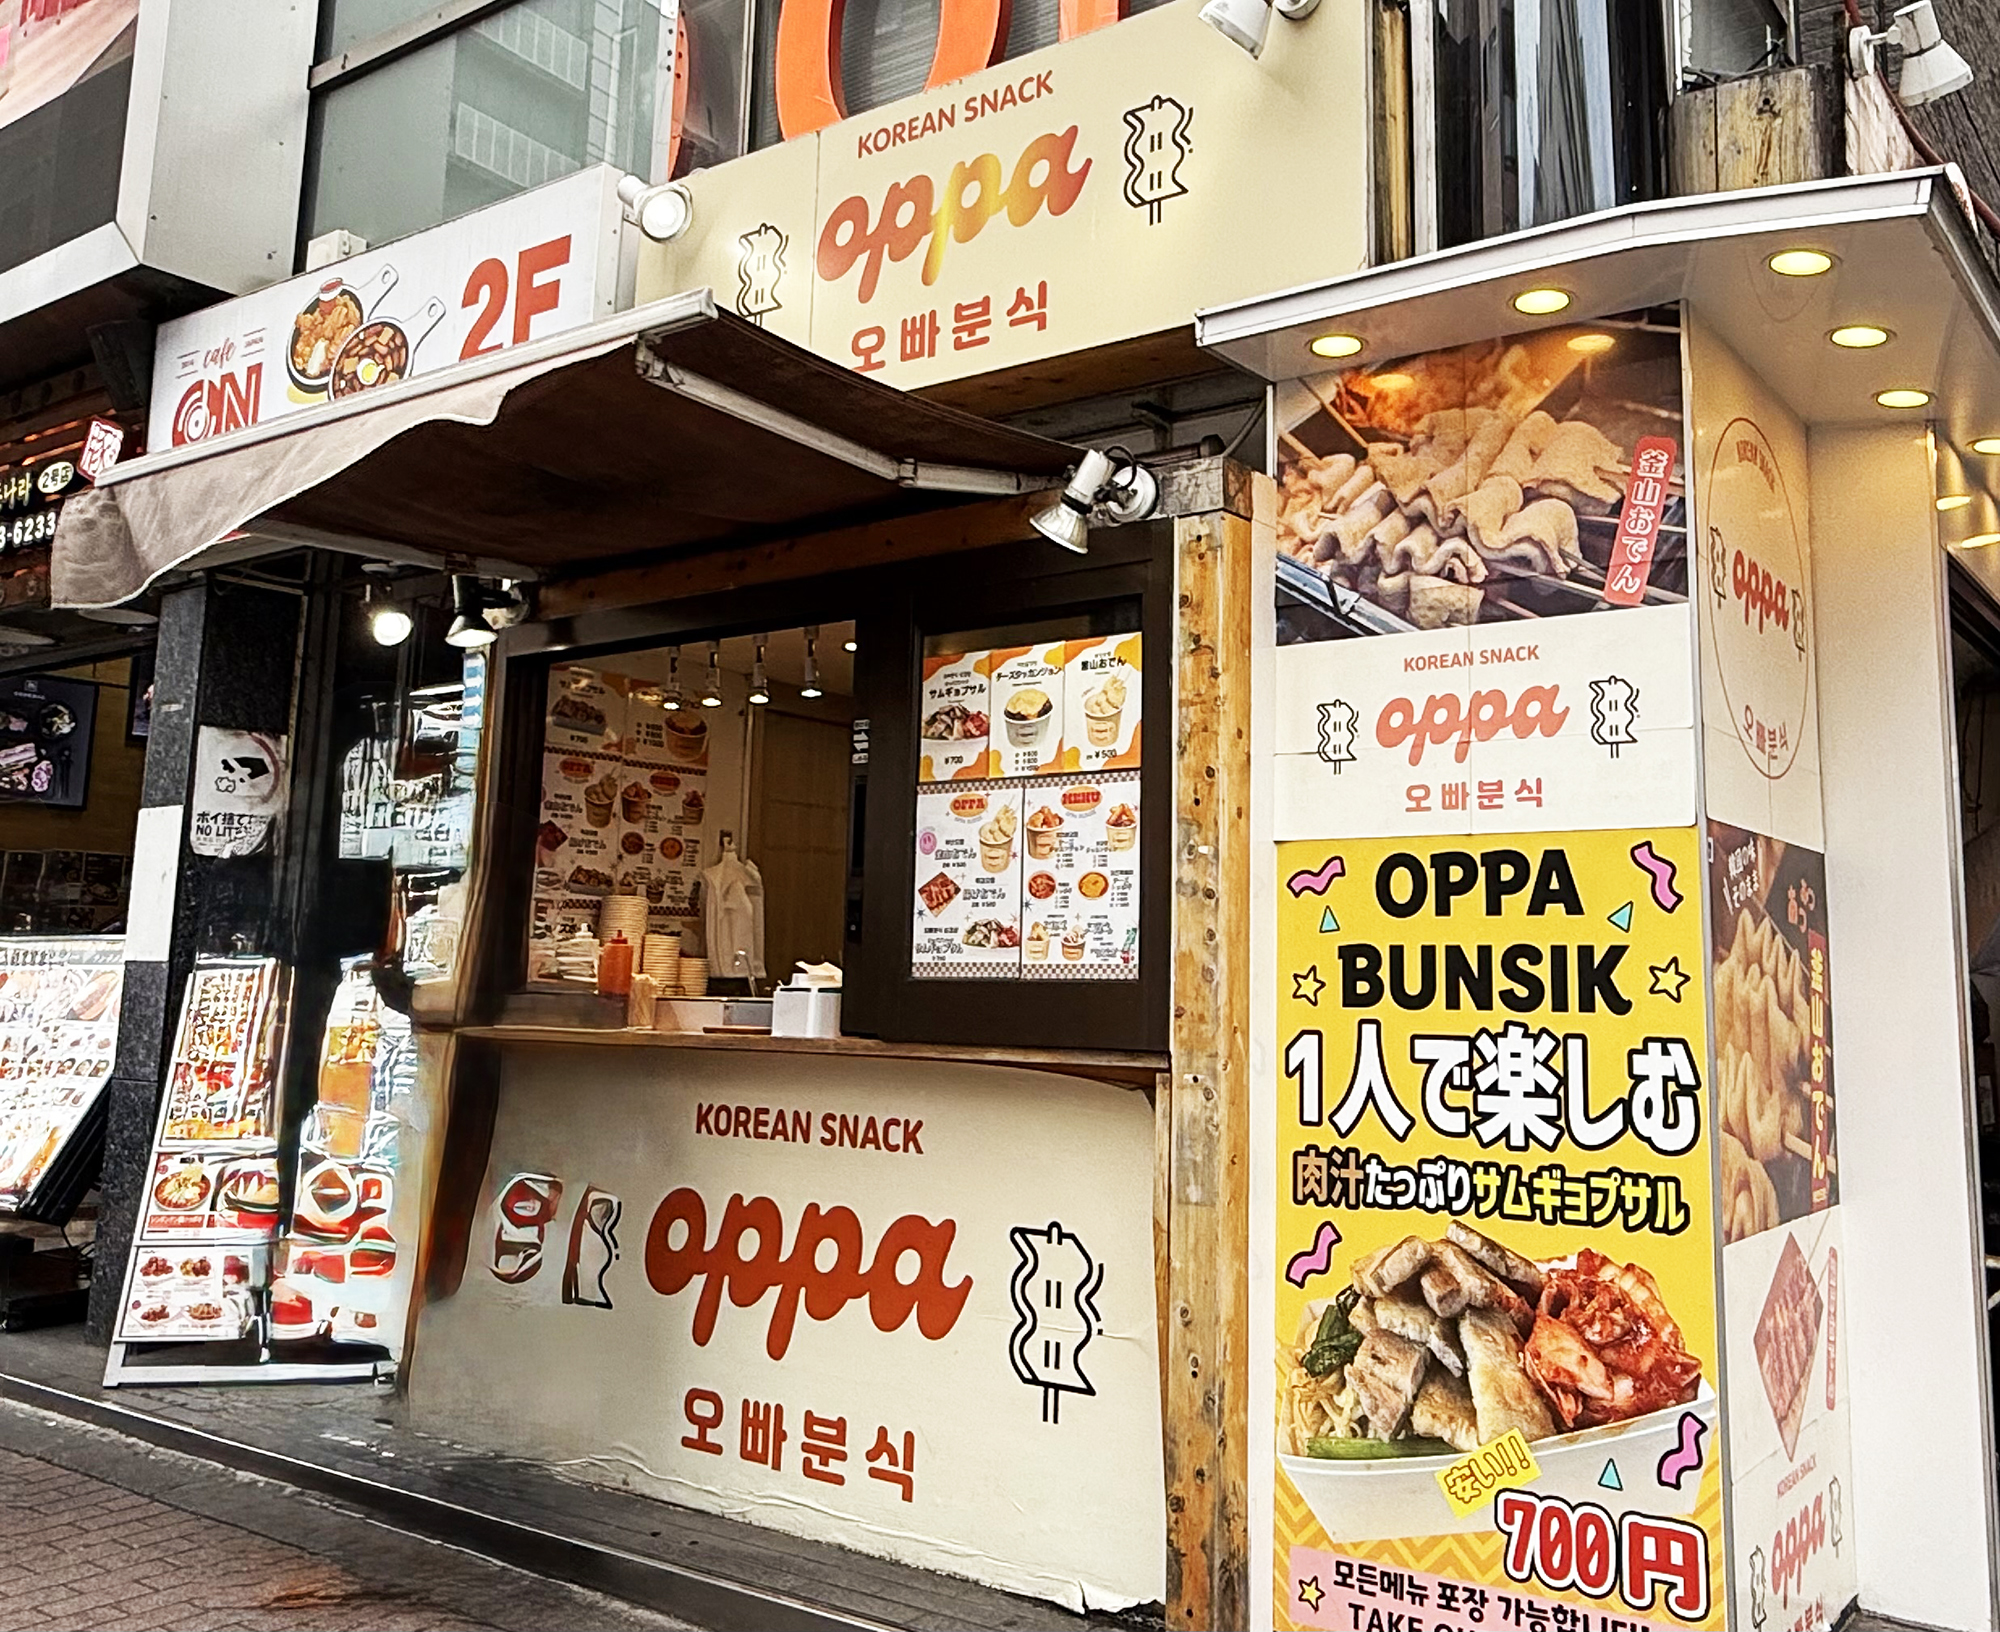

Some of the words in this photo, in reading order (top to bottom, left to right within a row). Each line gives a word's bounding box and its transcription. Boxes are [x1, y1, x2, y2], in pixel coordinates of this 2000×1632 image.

[857, 104, 957, 160] KOREAN
[963, 69, 1055, 125] SNACK
[816, 125, 1092, 304] oppa
[461, 233, 572, 361] 2F
[851, 280, 1049, 373] 오빠분식
[1609, 446, 1670, 595] 釜山おでん
[1732, 549, 1790, 635] oppa
[1403, 650, 1475, 673] KOREAN
[1480, 644, 1540, 665] SNACK
[1375, 683, 1571, 768] oppa
[1404, 777, 1544, 814] 오빠분식
[1374, 849, 1585, 919] OPPA
[1338, 943, 1633, 1016] BUNSIK
[695, 1102, 812, 1145] KOREAN
[820, 1111, 924, 1155] SNACK
[1286, 1019, 1701, 1157] 1人で楽しむ
[1293, 1144, 1691, 1235] 肉汁たっぷりサムギョプサル
[644, 1187, 973, 1361] oppa
[680, 1387, 917, 1503] 오빠분식
[1333, 1559, 1430, 1602] 모든메뉴
[1436, 1581, 1490, 1623] 포장
[1497, 1595, 1650, 1632] 가능합
[1497, 1489, 1708, 1618] 700円
[1772, 1491, 1826, 1610] oppa
[1787, 1591, 1824, 1632] 분식
